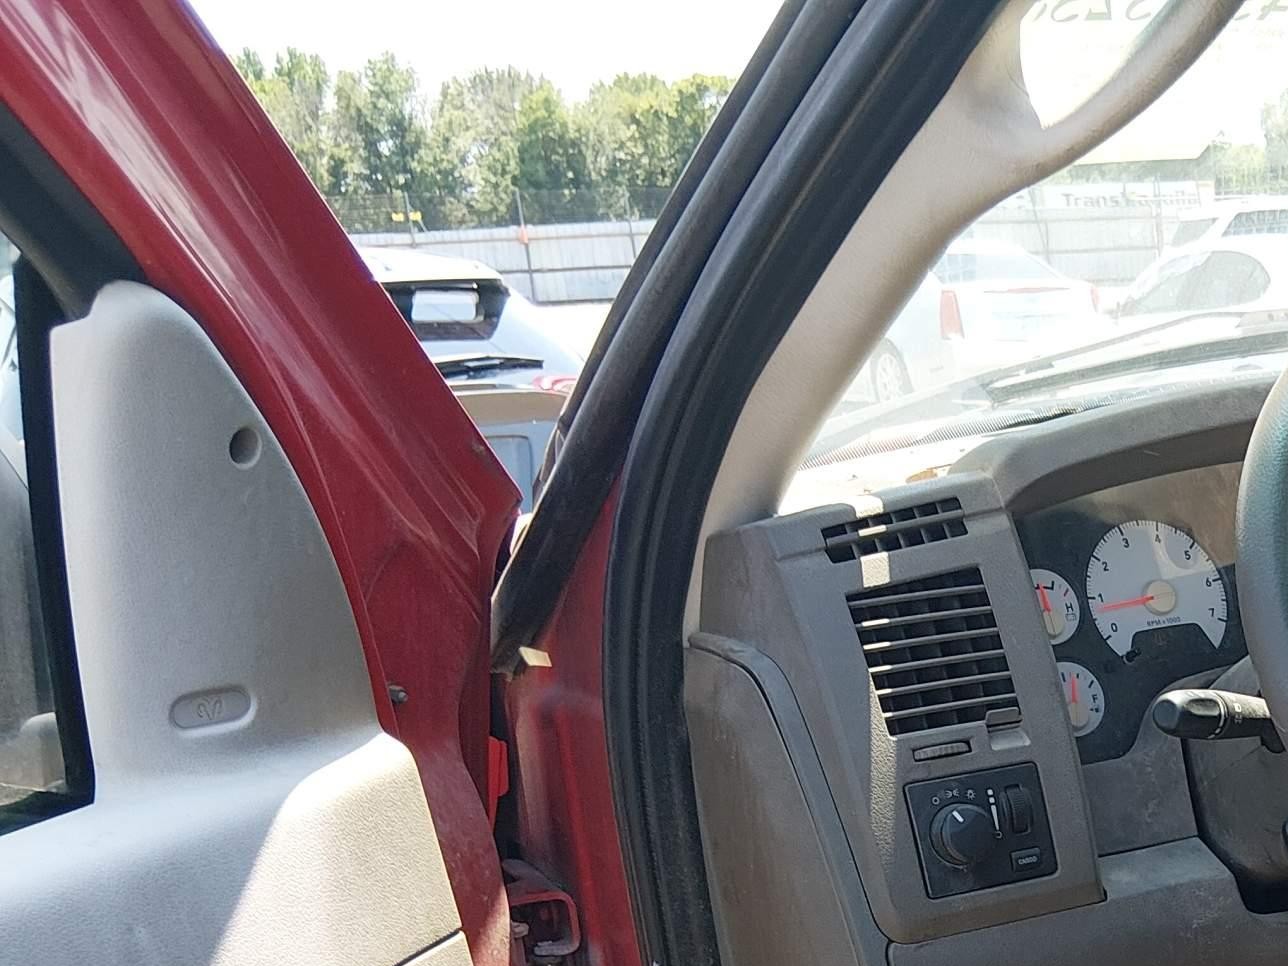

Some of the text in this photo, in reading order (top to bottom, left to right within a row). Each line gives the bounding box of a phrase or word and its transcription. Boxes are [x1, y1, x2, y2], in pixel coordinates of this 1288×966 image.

[1122, 538, 1130, 548] 3
[1154, 534, 1162, 544] 4
[1184, 550, 1191, 560] 5
[1101, 562, 1109, 572] 2
[1205, 577, 1212, 587] 6
[1097, 593, 1104, 602] 1
[1065, 602, 1074, 613] H
[1207, 607, 1215, 618] 7
[1146, 618, 1161, 627] RPM
[1166, 616, 1181, 624] 1000
[1110, 622, 1118, 632] 0
[1092, 694, 1098, 704] F
